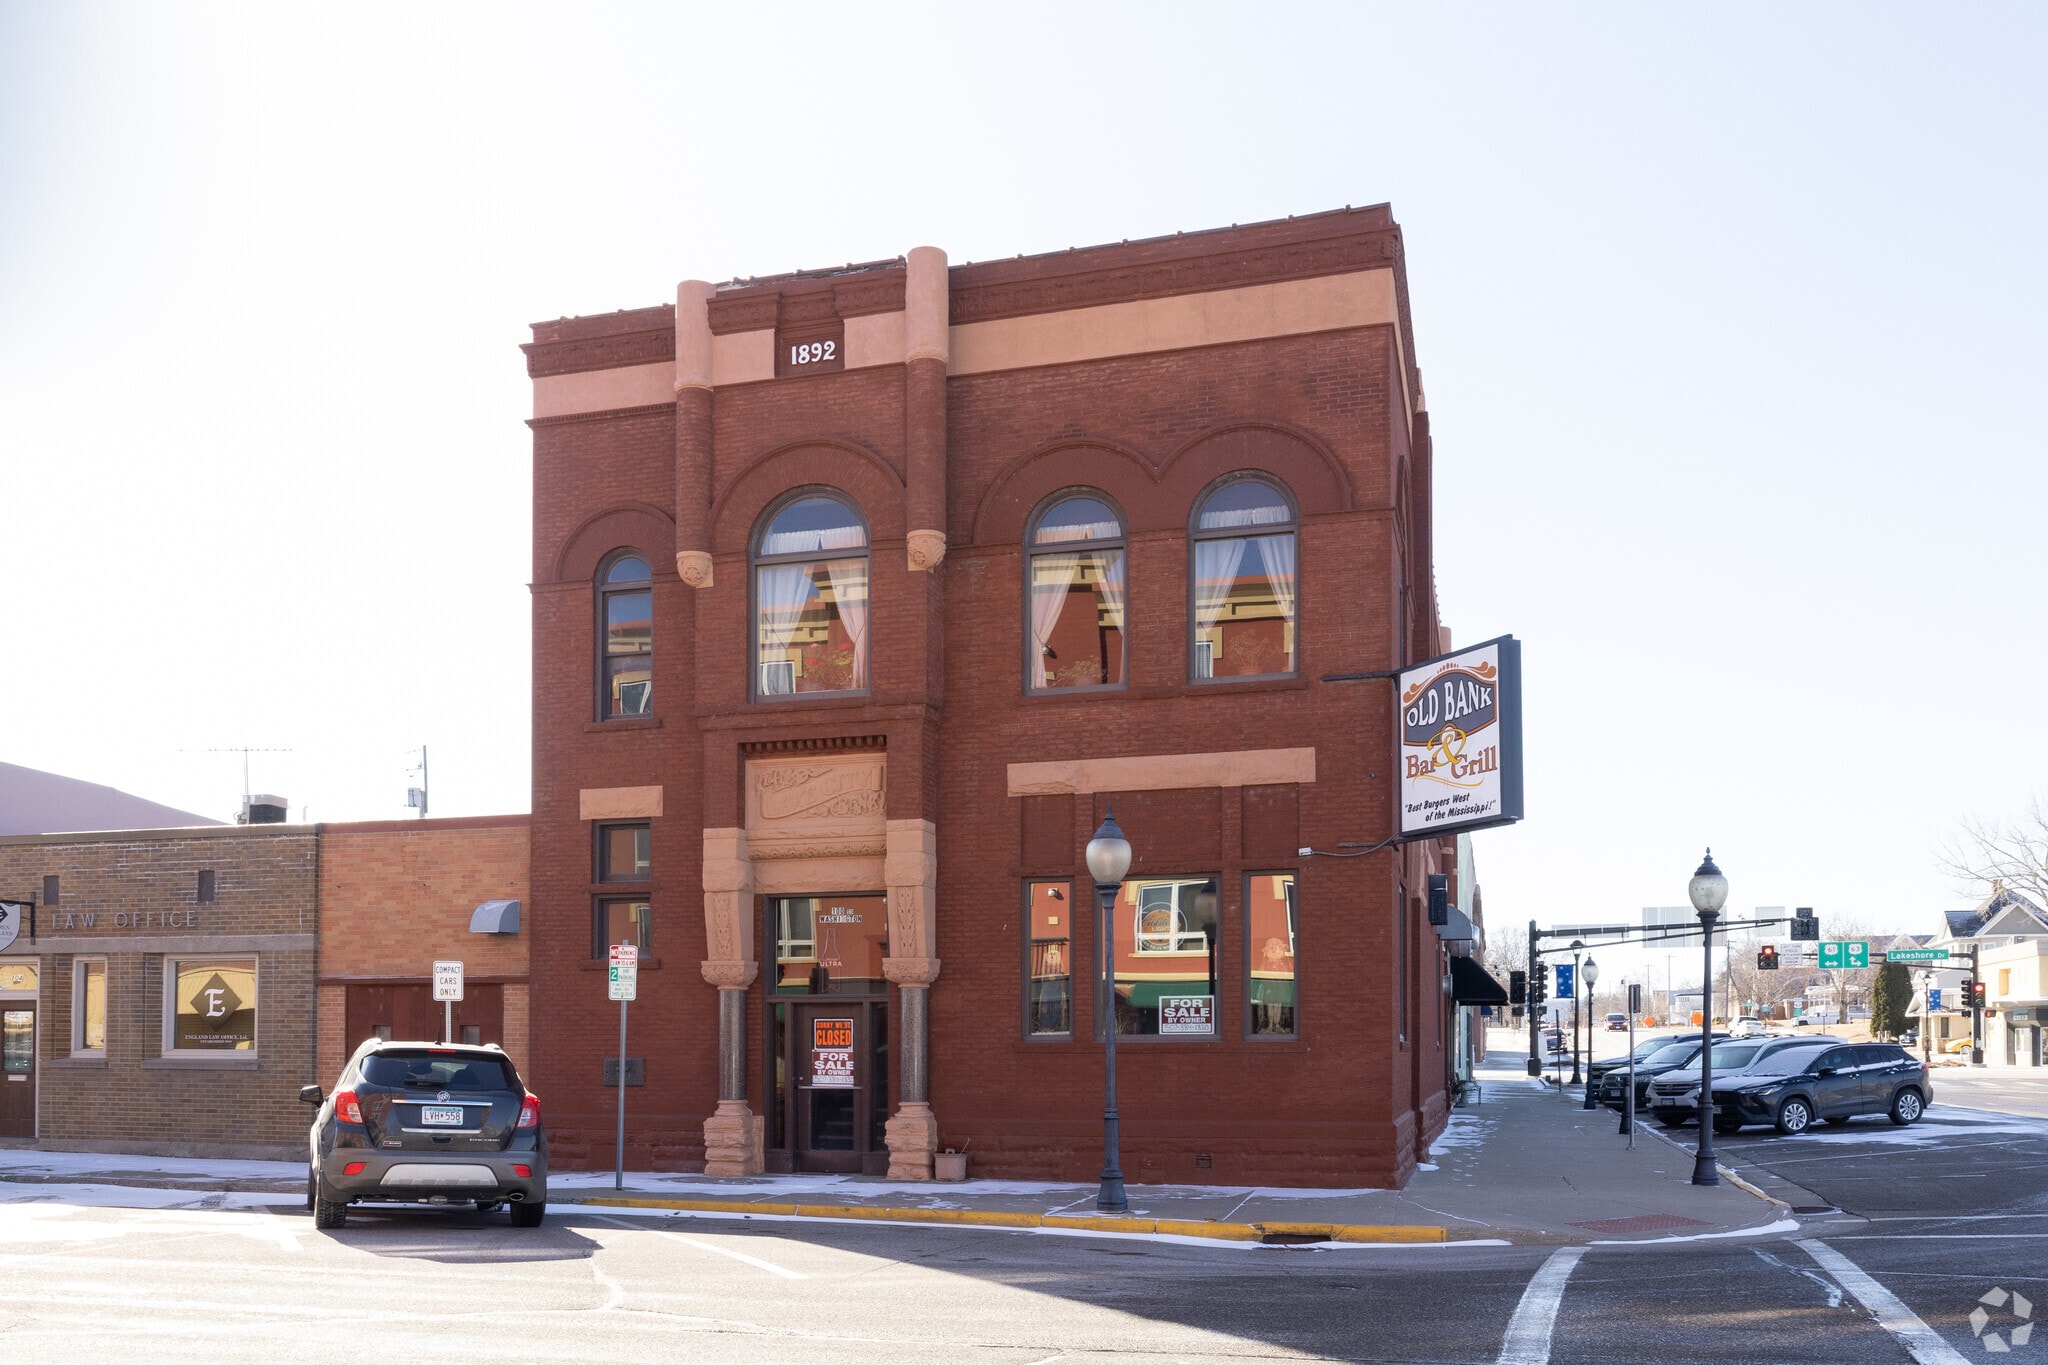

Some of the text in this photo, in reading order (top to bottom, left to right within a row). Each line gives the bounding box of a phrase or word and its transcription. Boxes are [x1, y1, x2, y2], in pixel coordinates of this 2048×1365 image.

[791, 340, 836, 365] 1892
[1406, 679, 1492, 727] OLD BANK
[1427, 728, 1467, 767] &
[1406, 745, 1498, 779] Bar Grill
[820, 769, 873, 796] CITY
[1424, 798, 1451, 811] Burgers
[1453, 793, 1471, 803] West
[1425, 811, 1433, 822] of
[1434, 809, 1446, 821] the
[52, 911, 196, 929] LAW OFFICE
[1891, 952, 1934, 960] Lakeshore
[436, 966, 460, 974] COMPACT
[611, 969, 618, 980] 2
[440, 977, 457, 985] CARS
[440, 988, 456, 996] ONLY
[204, 988, 226, 1017] E
[1170, 999, 1203, 1007] FOR
[1164, 1007, 1210, 1017] SALE
[816, 1029, 851, 1046] CLOSED
[820, 1052, 849, 1061] FOR
[814, 1060, 854, 1070] SALE
[424, 1111, 461, 1120] LVH 558
